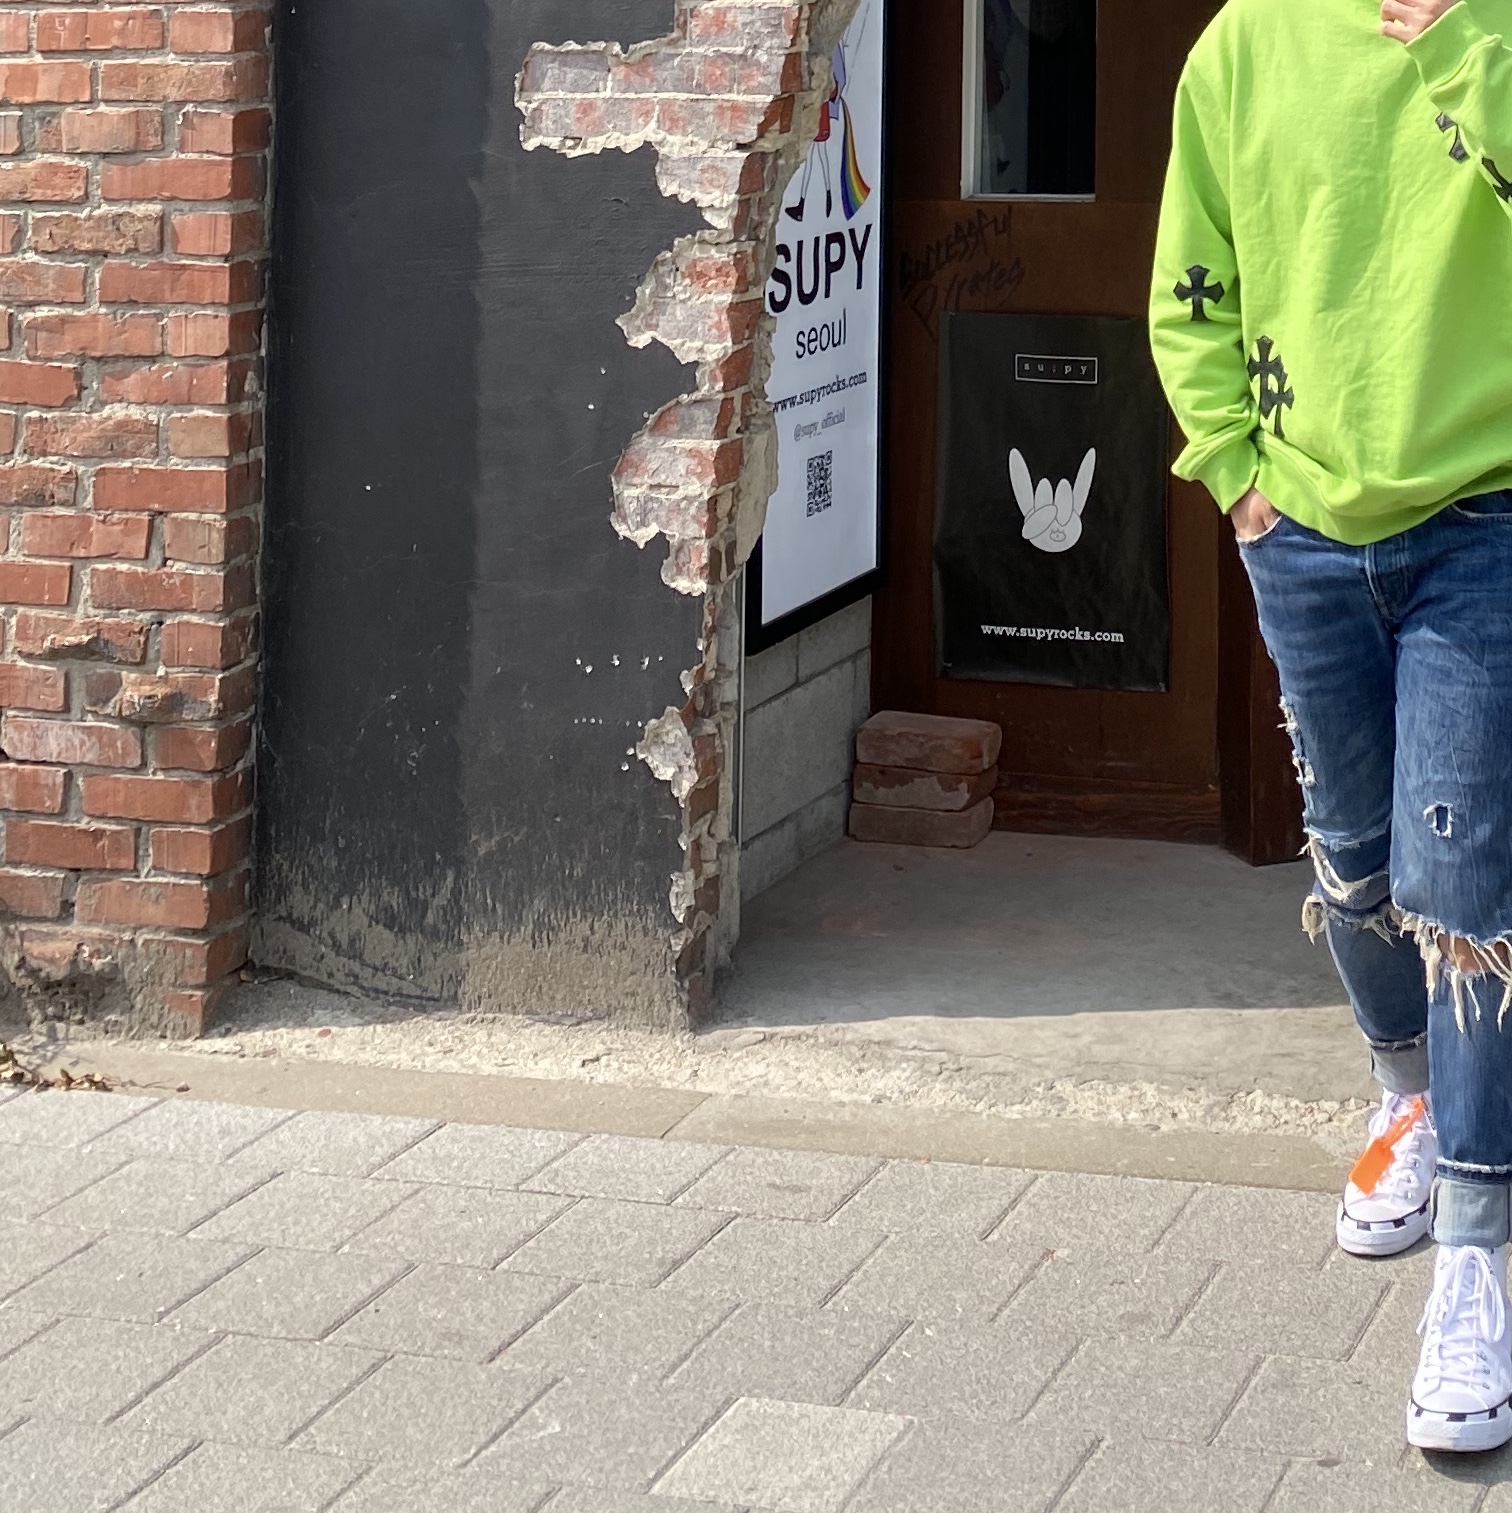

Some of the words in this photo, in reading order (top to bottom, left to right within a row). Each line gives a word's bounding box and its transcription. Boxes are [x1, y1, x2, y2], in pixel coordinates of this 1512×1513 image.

[769, 224, 872, 313] SUPY
[796, 308, 846, 359] seoul
[980, 624, 1125, 643] www.supyrocks.com
